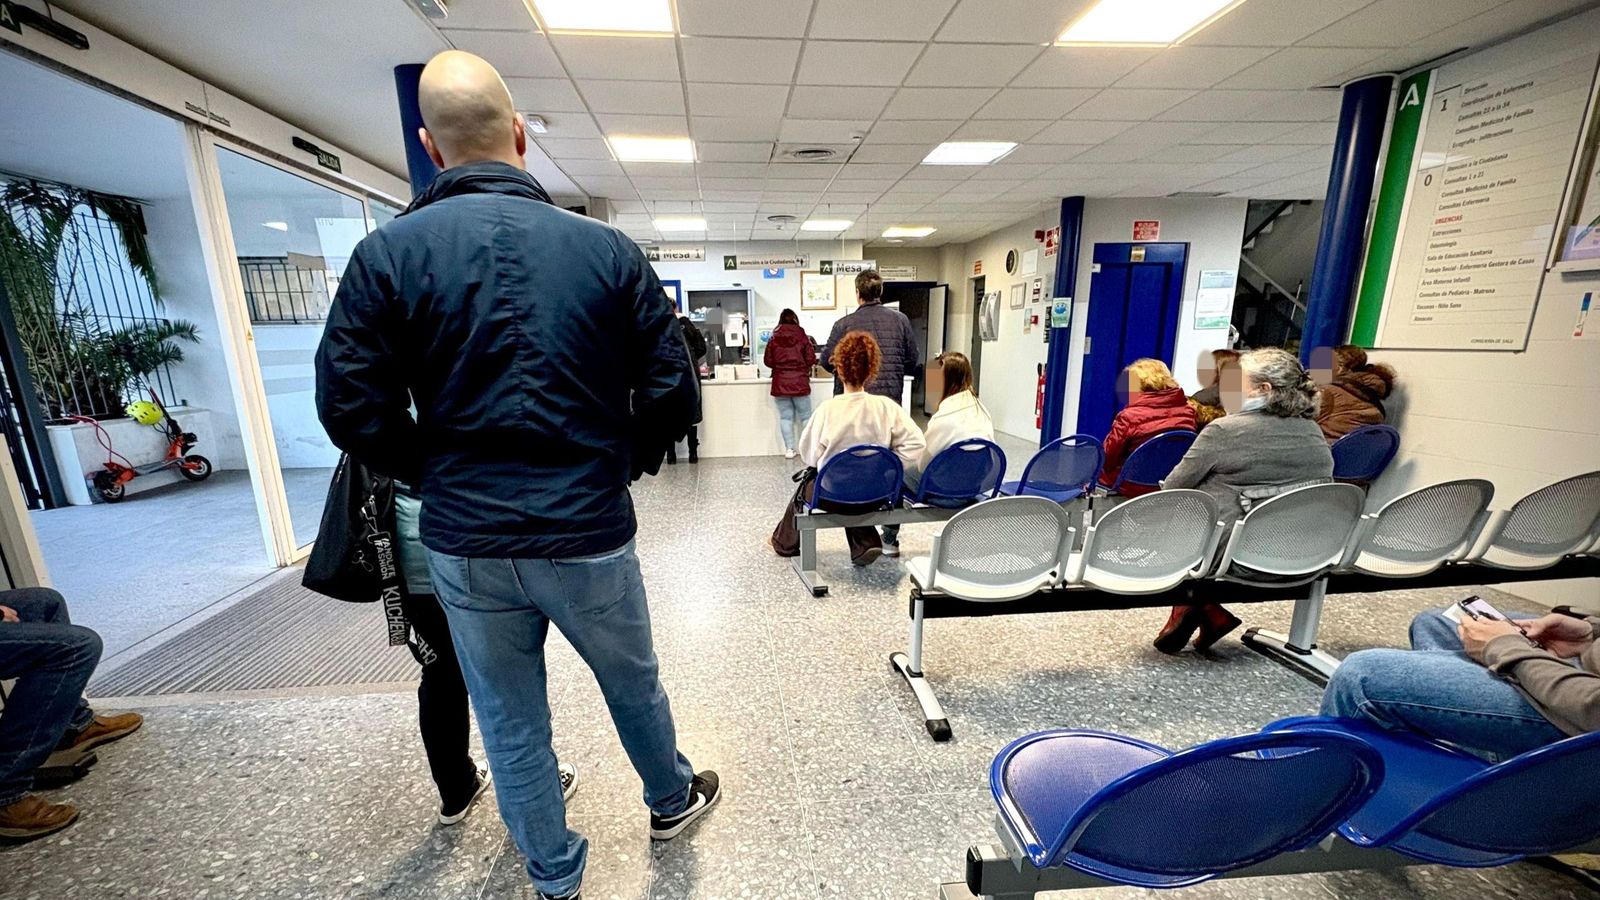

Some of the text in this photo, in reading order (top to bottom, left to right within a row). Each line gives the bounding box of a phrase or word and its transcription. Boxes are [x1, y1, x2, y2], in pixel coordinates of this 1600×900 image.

[1440, 98, 1448, 112] 1
[1455, 124, 1479, 134] Consultas
[1480, 118, 1504, 128] Medicina
[1513, 108, 1534, 119] Familia
[1458, 110, 1482, 122] Consultas
[1424, 174, 1432, 186] 0
[1444, 176, 1467, 185] Consultas
[1441, 189, 1464, 198] Consultas
[1465, 184, 1488, 194] Medicina
[1496, 178, 1516, 187] Familia
[1438, 202, 1461, 211] Consultas
[1434, 214, 1463, 224] URGENCIAS
[663, 249, 690, 259] Mesa
[695, 249, 700, 259] 1
[836, 263, 862, 272] Mesa
